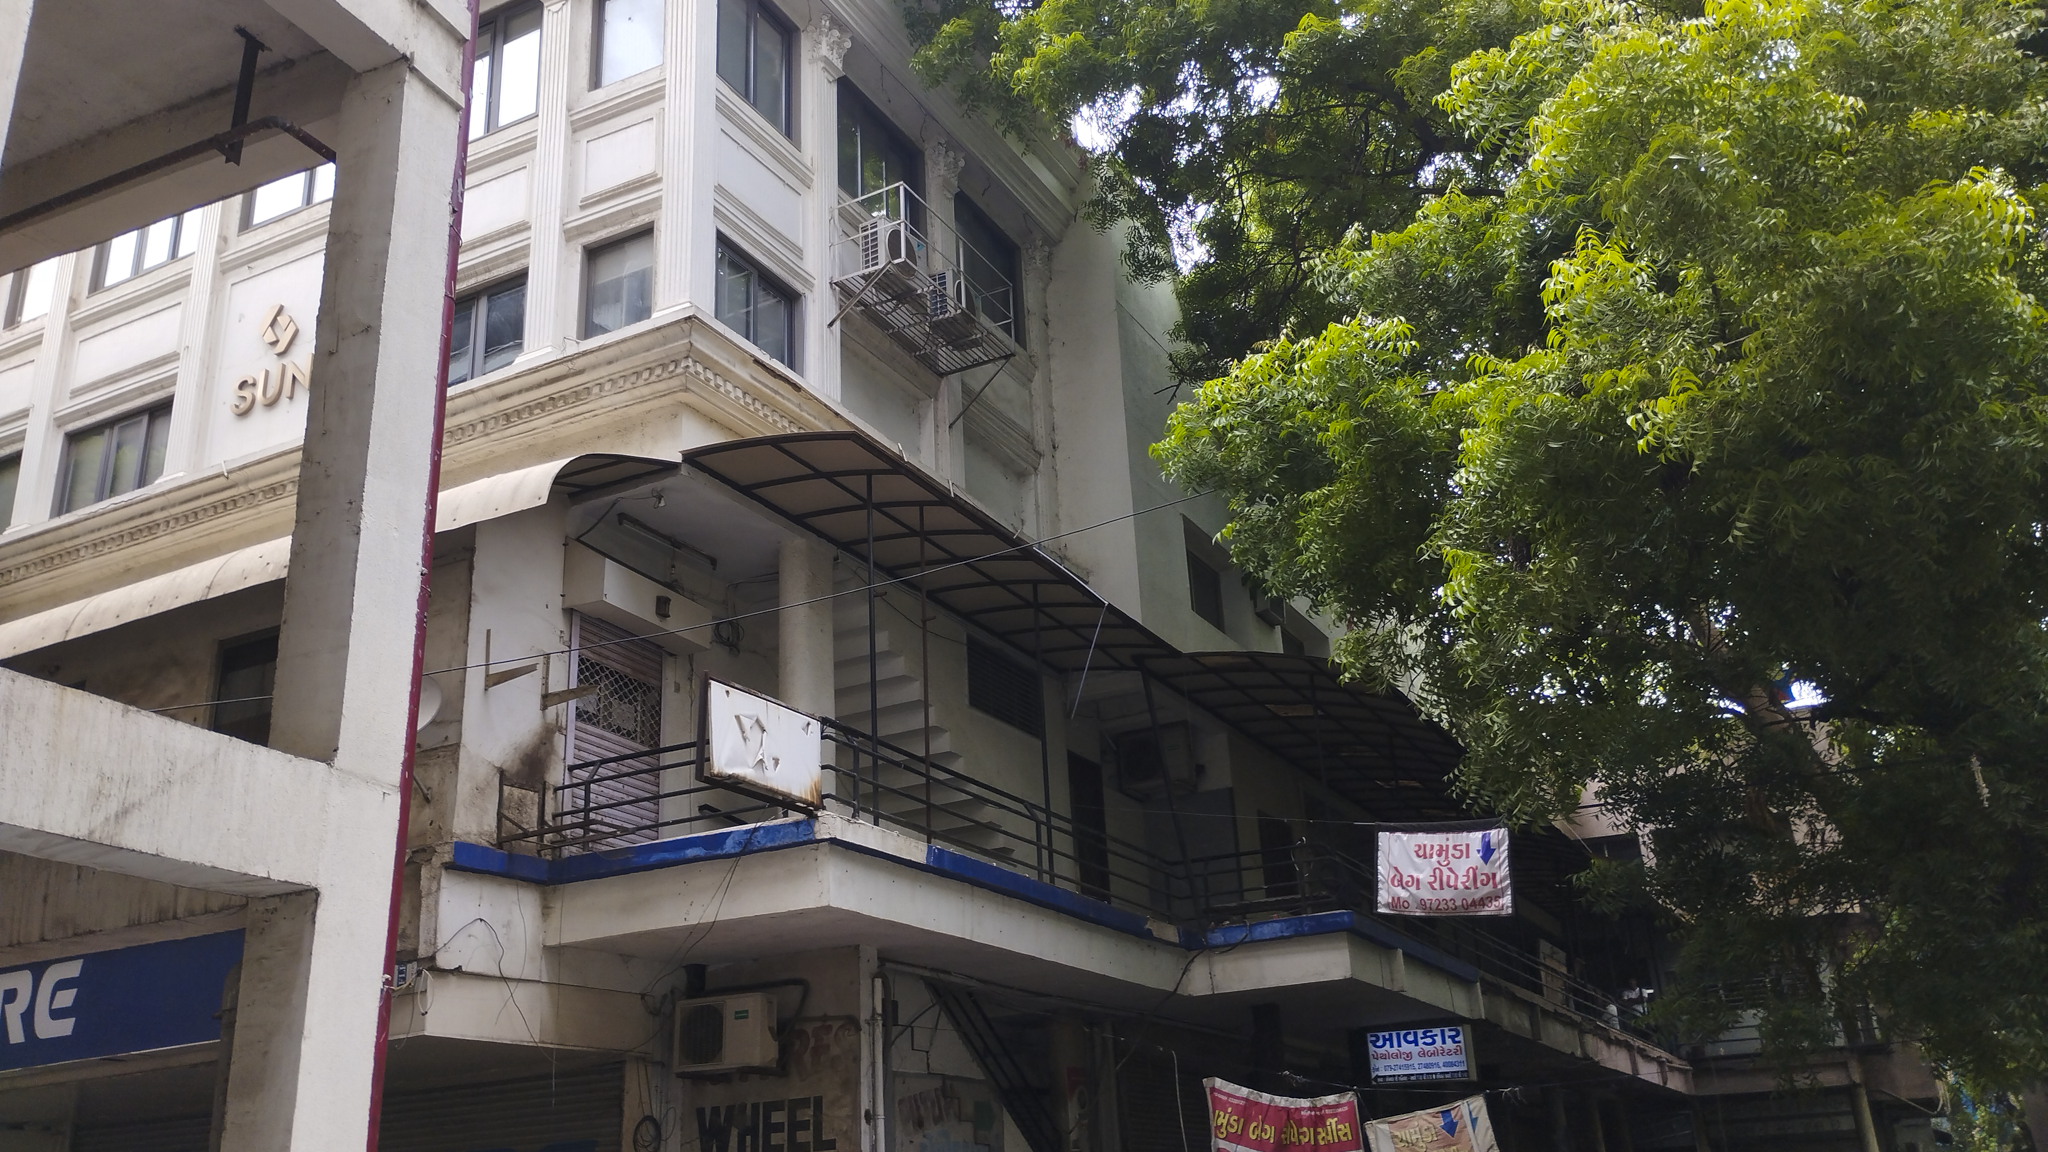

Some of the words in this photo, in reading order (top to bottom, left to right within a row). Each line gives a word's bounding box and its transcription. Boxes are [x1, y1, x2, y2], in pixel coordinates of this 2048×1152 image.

[230, 353, 315, 416] SUN
[1414, 837, 1470, 867] ચામુંડા
[1390, 866, 1420, 890] બેગ
[1427, 865, 1497, 891] રીપેરીંગ
[1461, 895, 1501, 909] 04435
[1369, 1028, 1462, 1048] આવકાર
[1372, 1049, 1412, 1061] પેથોલોજી
[1417, 1045, 1463, 1058] લેબોરેટરી
[695, 1095, 837, 1152] WHEEL
[1248, 1115, 1275, 1144] બેગ
